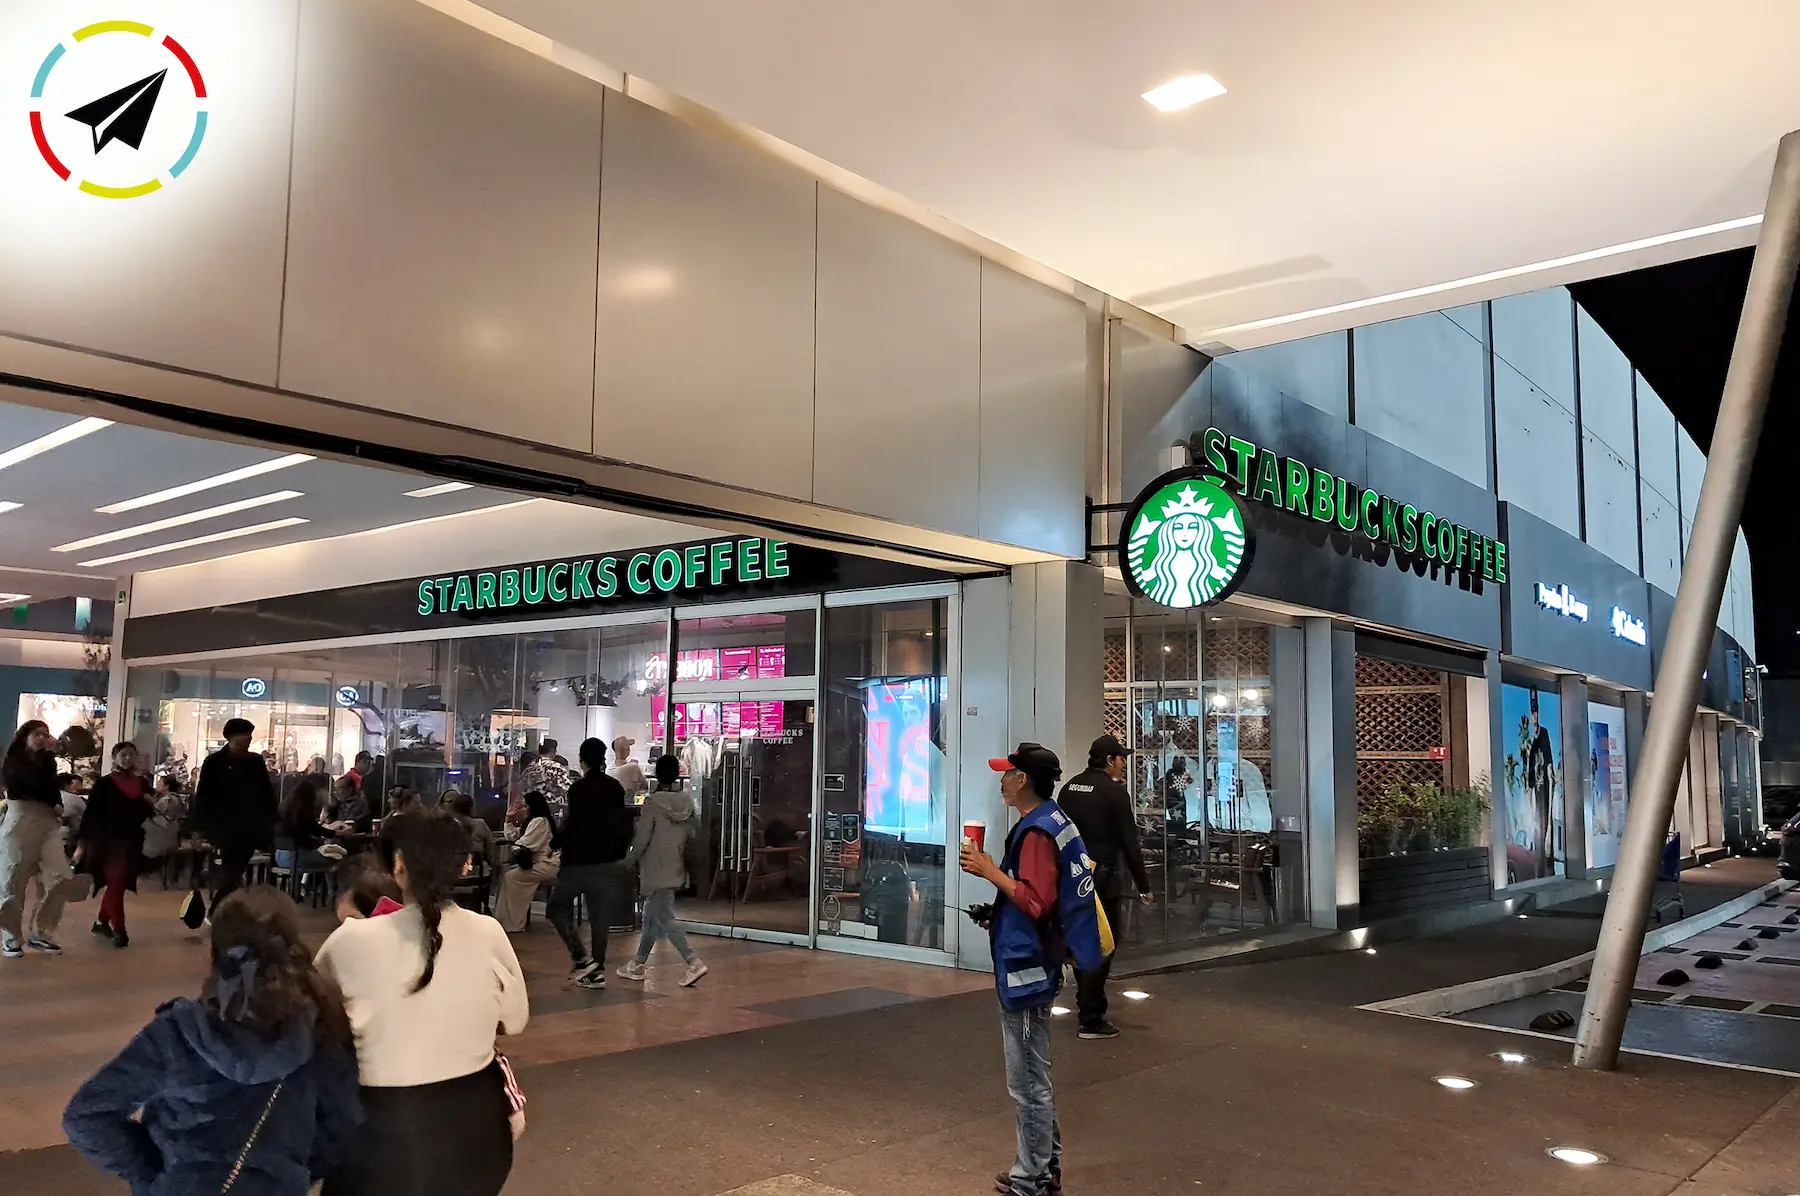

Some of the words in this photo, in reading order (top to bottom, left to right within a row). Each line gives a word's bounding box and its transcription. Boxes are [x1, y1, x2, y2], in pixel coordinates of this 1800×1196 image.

[1203, 426, 1418, 553] STARBUCKS
[1422, 510, 1506, 584] COFFEE
[418, 557, 618, 616] STARBUCKS
[627, 538, 790, 593] COFFEE
[754, 728, 804, 737] BUCKS
[763, 736, 794, 745] COFFEE
